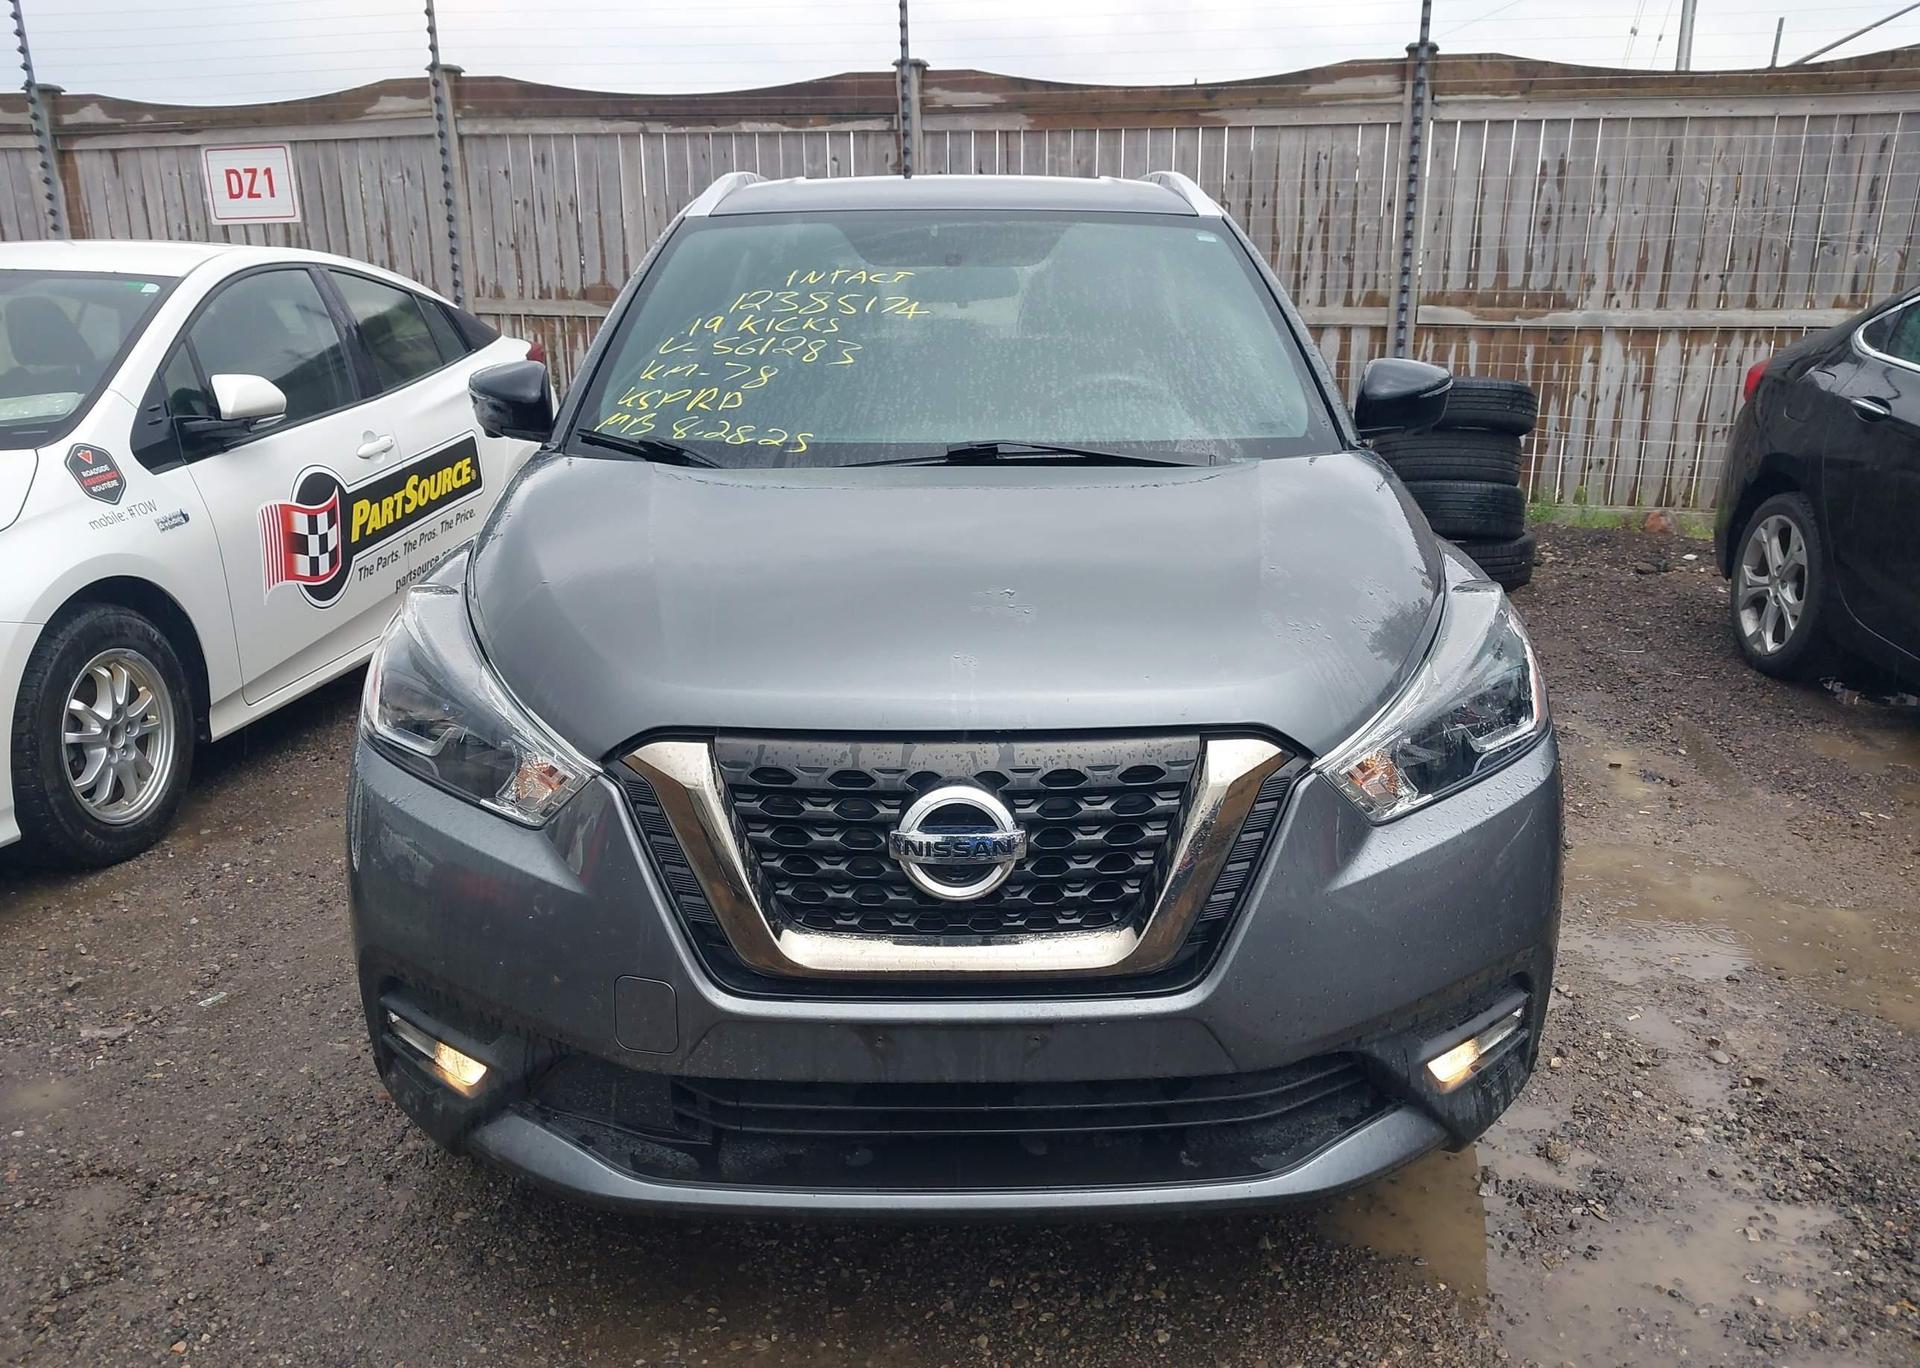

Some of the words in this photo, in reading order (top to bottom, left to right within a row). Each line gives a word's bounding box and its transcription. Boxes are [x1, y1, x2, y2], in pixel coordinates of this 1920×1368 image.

[225, 167, 275, 199] DZ1
[786, 269, 915, 287] INTACT
[729, 291, 931, 319] 12385174
[737, 316, 839, 335] KICKS
[724, 362, 779, 389] 78
[88, 510, 129, 531] mobile:
[126, 499, 158, 519] #TOW
[358, 565, 374, 582] The
[376, 550, 400, 572] Parts.
[403, 539, 417, 556] The
[419, 529, 438, 547] Pros.
[440, 517, 454, 534] The
[455, 508, 476, 526] Price.
[904, 839, 1014, 858] NISSAN
